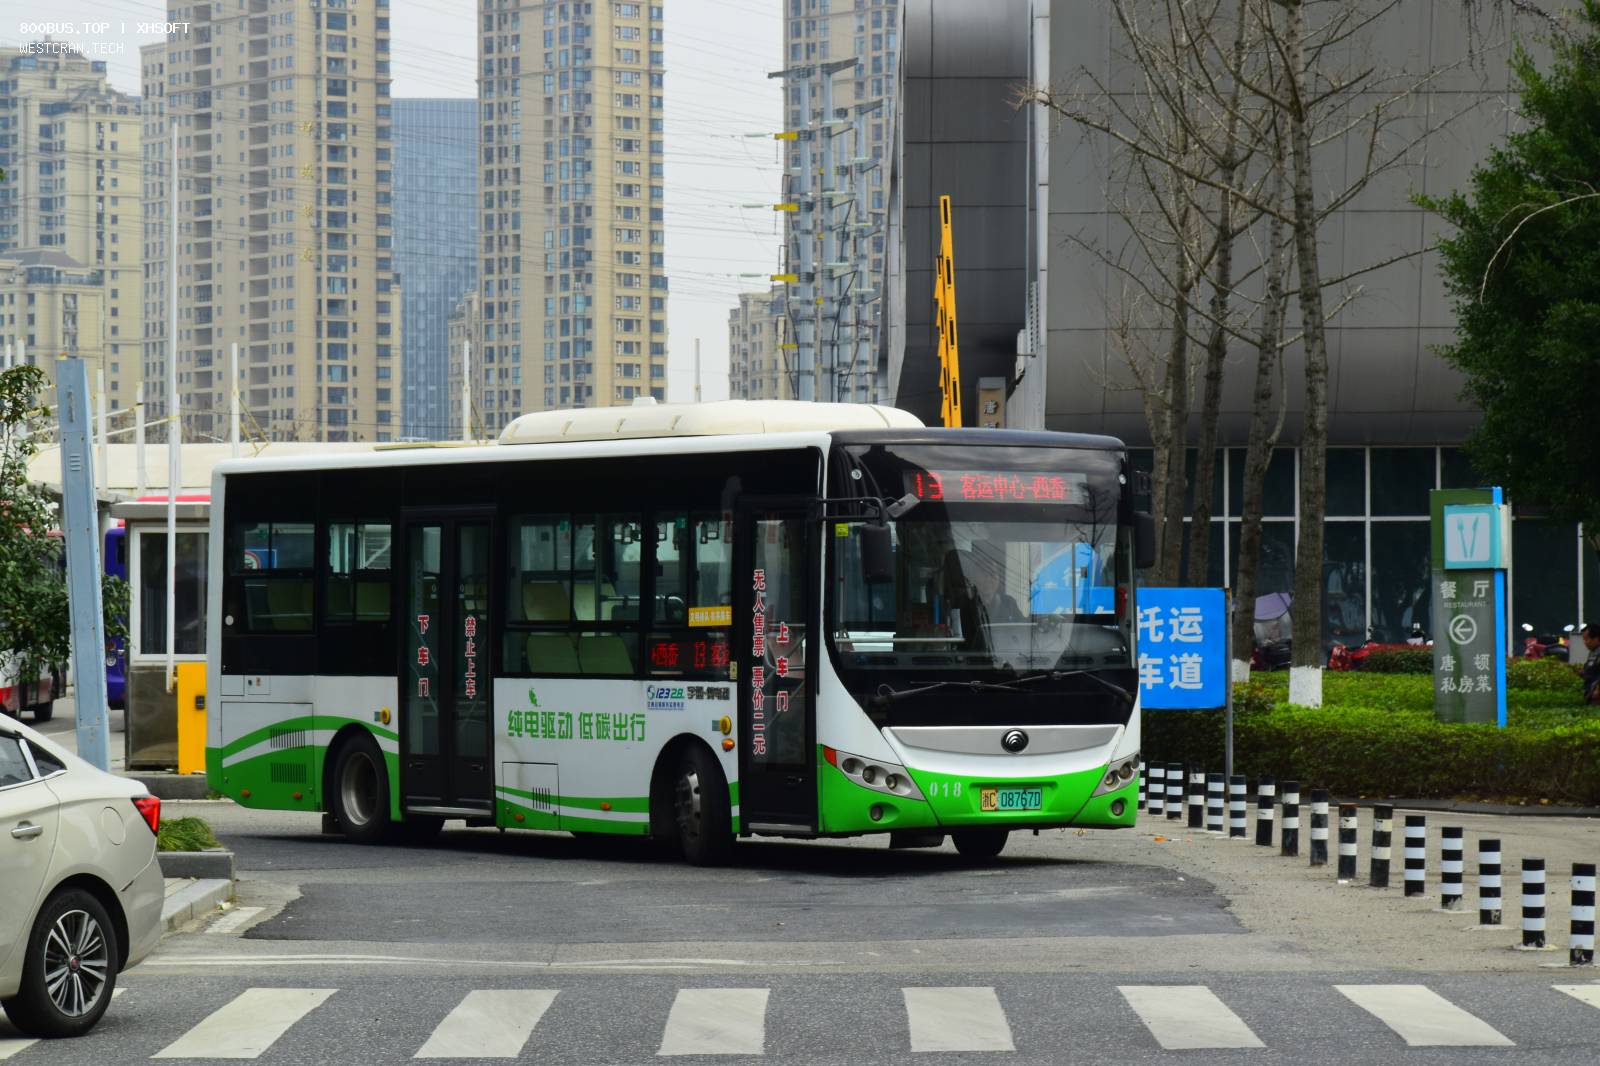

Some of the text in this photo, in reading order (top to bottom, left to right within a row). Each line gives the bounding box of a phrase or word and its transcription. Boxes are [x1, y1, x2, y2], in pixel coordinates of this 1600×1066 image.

[916, 472, 944, 499] 13
[1440, 580, 1490, 599] 餐厅
[1444, 601, 1486, 609] RESTAURANT
[1136, 606, 1203, 643] 托运
[418, 614, 429, 697] 下车门
[465, 615, 476, 699] 禁止上车
[752, 569, 766, 755] 无人售票 票价二元
[776, 621, 789, 712] 上车门
[1440, 653, 1490, 671] 唐顿
[1138, 652, 1203, 690] 车道
[1440, 674, 1492, 694] 私房菜
[656, 688, 684, 700] 12328
[507, 709, 646, 742] 纯电驱动 低碳出行
[930, 782, 961, 798] 018
